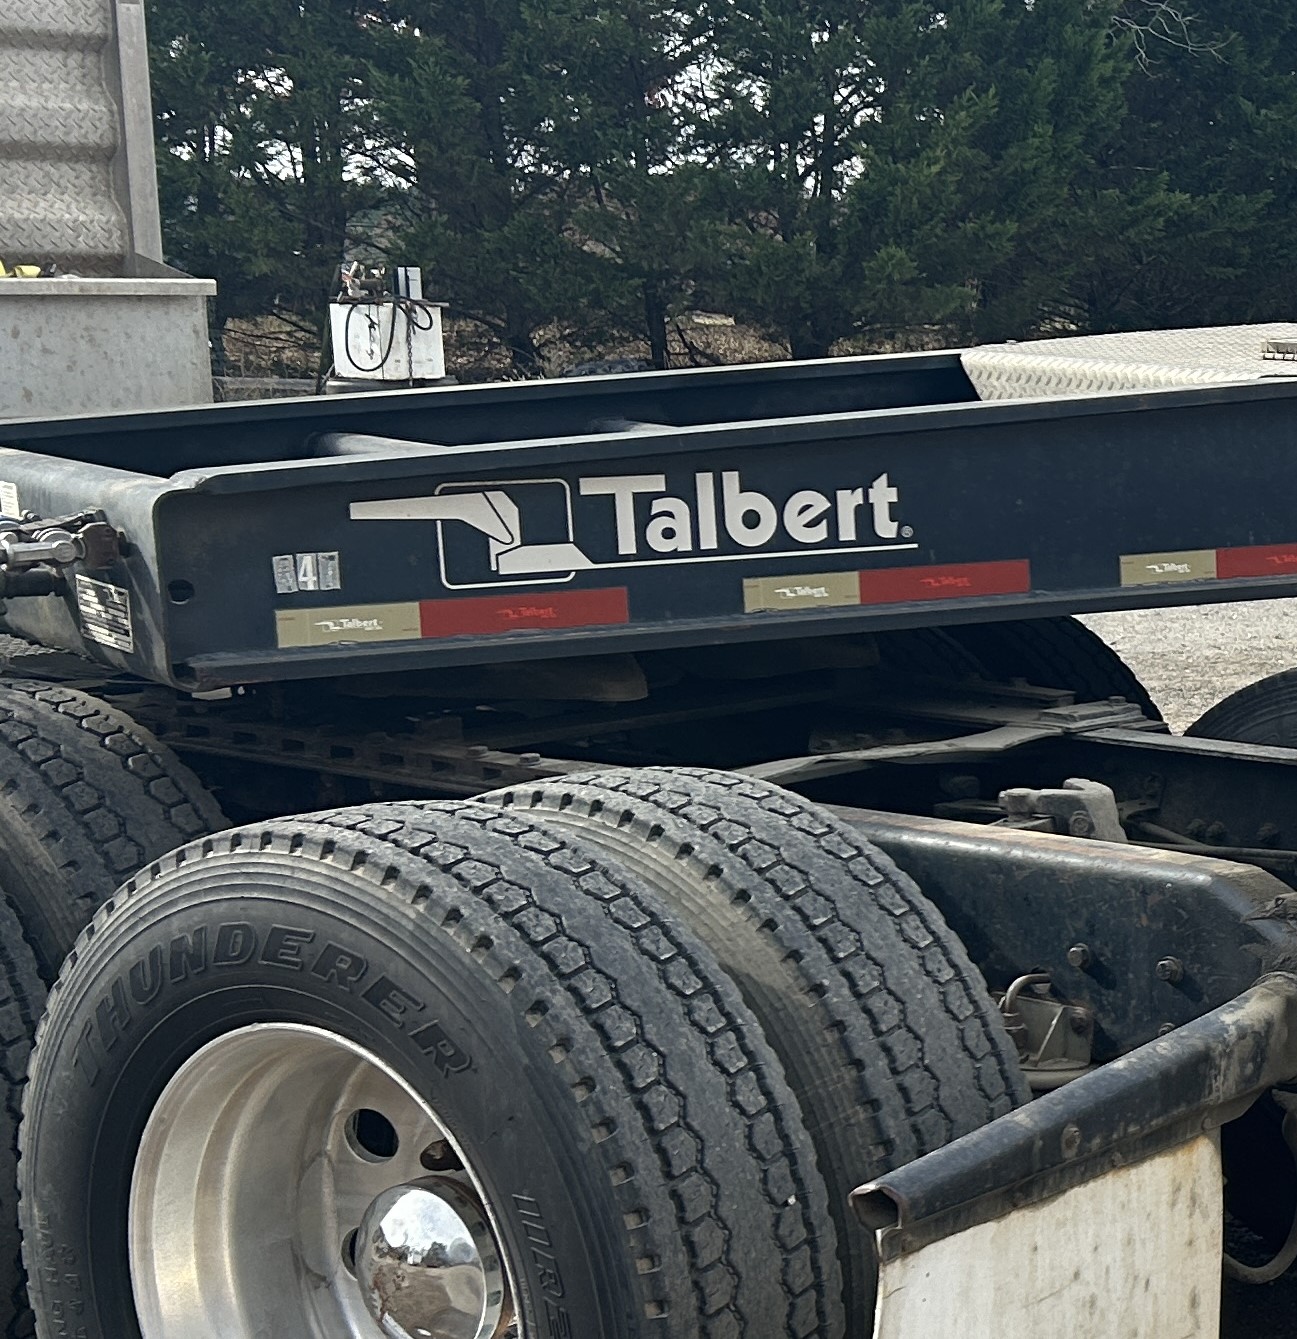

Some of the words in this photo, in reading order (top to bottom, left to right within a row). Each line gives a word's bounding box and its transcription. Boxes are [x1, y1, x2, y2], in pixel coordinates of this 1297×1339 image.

[578, 470, 899, 556] Talbert
[298, 555, 318, 590] 4
[72, 921, 474, 1087] THUNDERER
